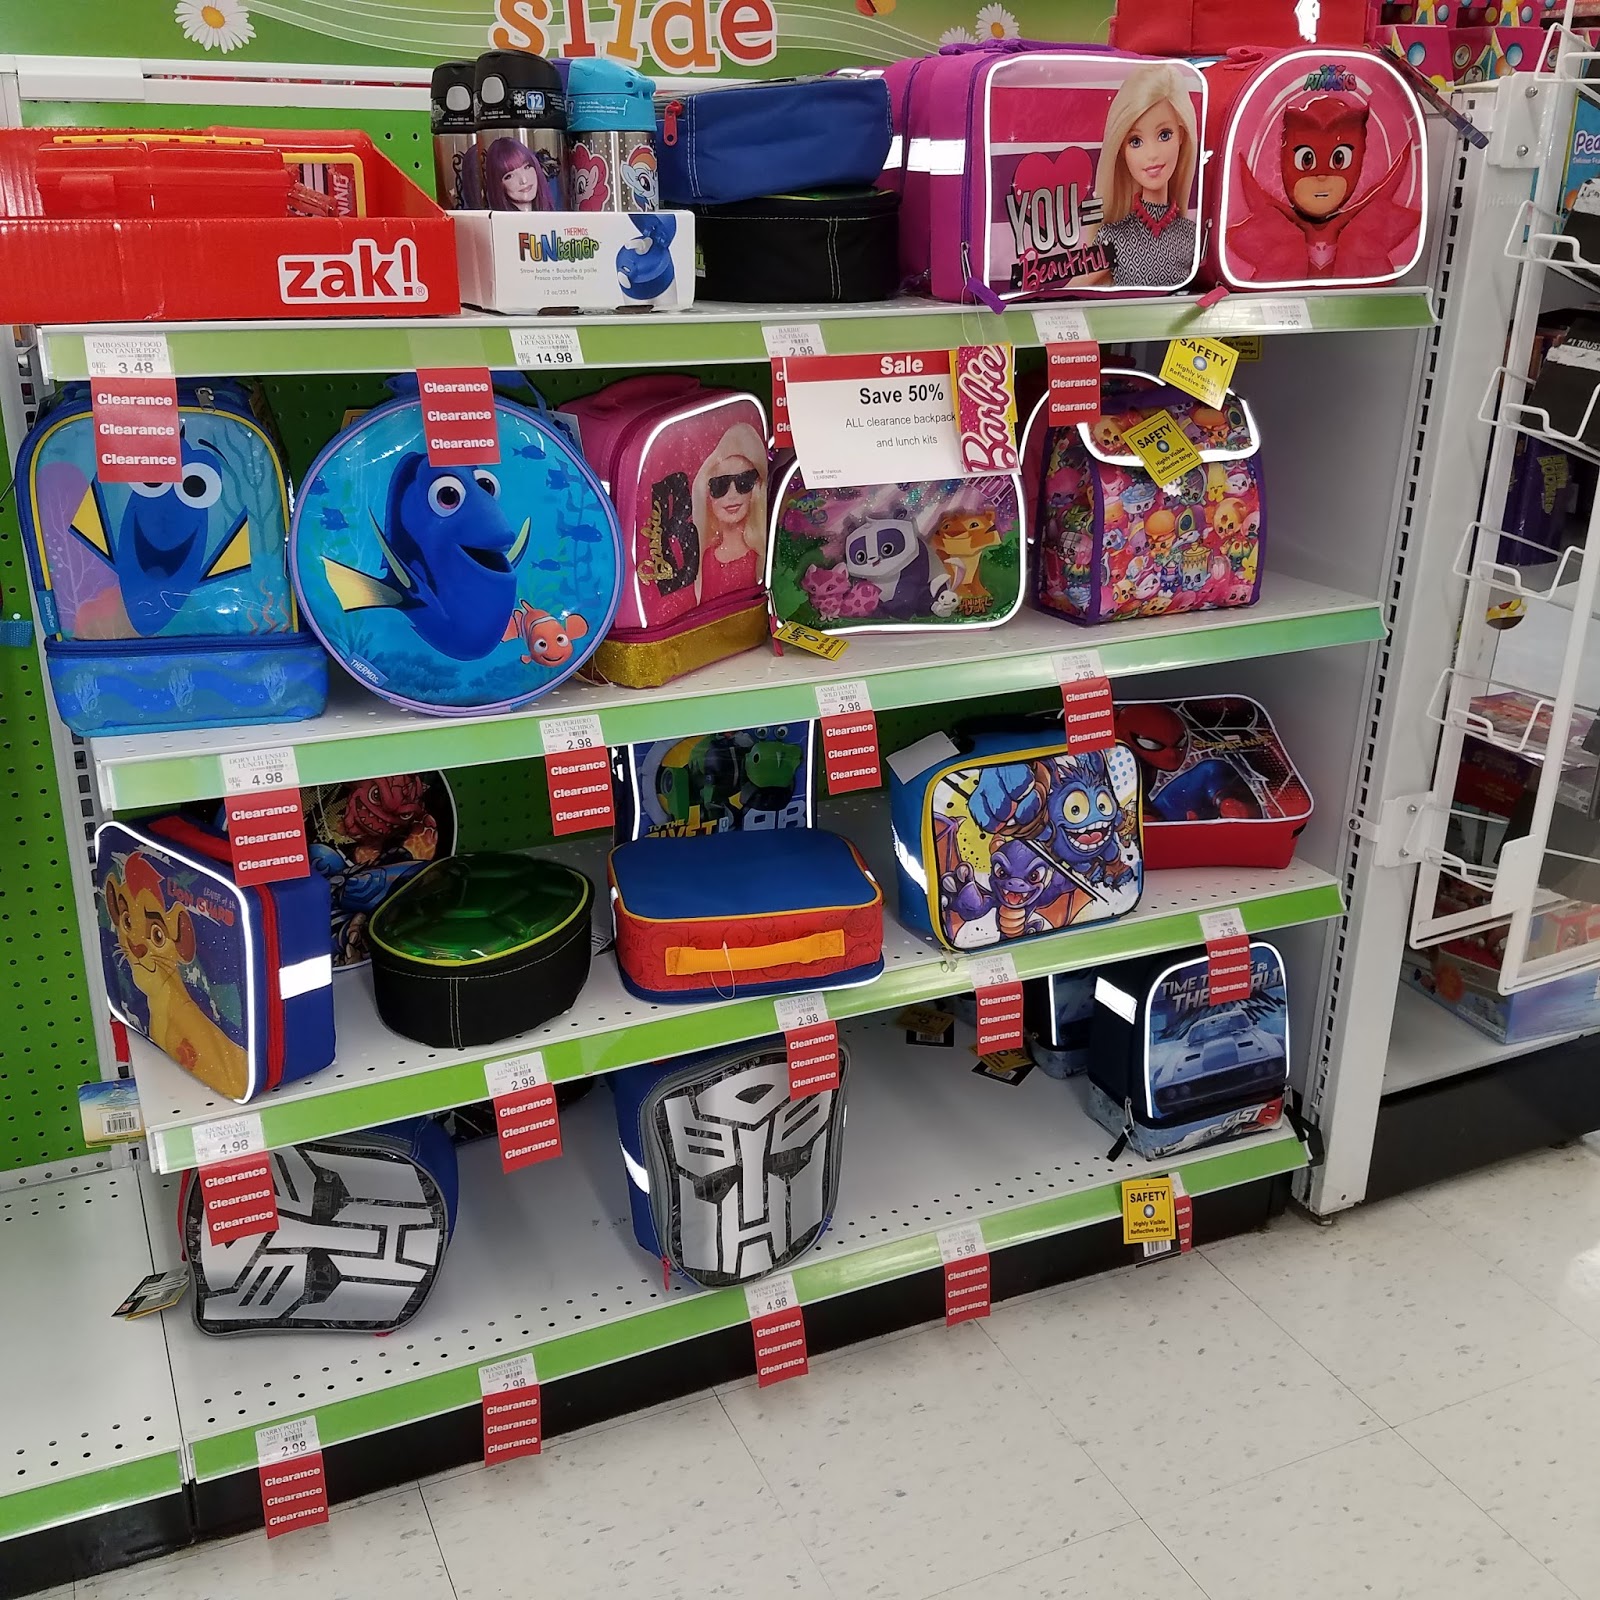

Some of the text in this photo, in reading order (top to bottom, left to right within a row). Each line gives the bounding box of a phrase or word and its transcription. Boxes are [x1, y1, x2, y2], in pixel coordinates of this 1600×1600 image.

[563, 227, 589, 236] THERMOS
[1020, 243, 1110, 291] Beautiful
[1057, 331, 1080, 341] 4.98
[536, 352, 573, 364] 14.98
[1050, 353, 1098, 365] Clearance
[1180, 338, 1228, 367] SAFETY
[118, 362, 154, 374] 3.48
[880, 355, 924, 375] Sale
[1175, 362, 1195, 376] Highly
[1051, 377, 1098, 389] Clearance
[1169, 367, 1199, 387] Reflective
[424, 383, 489, 393] Clearance
[859, 382, 944, 405] Save 50%
[97, 393, 173, 406] Clearance
[1051, 401, 1098, 413] Clearance
[427, 410, 492, 422] Clearance
[961, 345, 1018, 472] Barbie
[845, 411, 956, 429] ALL clearance backpack
[99, 423, 175, 436] Clearance
[1136, 423, 1172, 449] SAFETY
[431, 438, 495, 450] Clearance
[876, 434, 938, 448] and lunch kits
[101, 453, 177, 466] Clearance
[350, 658, 379, 684] THERMOS
[1074, 670, 1096, 680] 2.98
[1066, 689, 1109, 702] Clearance
[838, 701, 861, 713] 2.98
[1068, 709, 1111, 723] Clearance
[826, 723, 874, 737] Clearance
[1070, 729, 1112, 743] Clearance
[566, 737, 593, 750] 2.98
[828, 745, 876, 759] Clearance
[551, 760, 607, 776] Clearance
[830, 766, 877, 780] Clearance
[251, 772, 283, 786] 4.98
[553, 783, 609, 799] Clearance
[231, 804, 298, 821] Clearance
[556, 805, 611, 821] Clearance
[235, 829, 301, 846] Clearance
[238, 853, 305, 871] Clearance
[1210, 946, 1248, 958] Clearance
[1211, 964, 1249, 976] Clearance
[989, 973, 1009, 985] 2.98
[1161, 977, 1198, 996] TIME
[1211, 982, 1248, 995] Clearance
[980, 993, 1021, 1007] Clearance
[1172, 988, 1210, 1013] THE
[797, 1013, 819, 1026] 2.98
[980, 1012, 1021, 1025] Clearance
[790, 1033, 835, 1050] Clearance
[980, 1030, 1020, 1044] Clearance
[791, 1052, 836, 1070] Clearance
[496, 1067, 519, 1076] LUNCH
[511, 1075, 536, 1091] 2.98
[792, 1071, 837, 1089] Clearance
[499, 1097, 553, 1118] Clearance
[502, 1118, 556, 1138] Clearance
[219, 1139, 249, 1154] 4.98
[505, 1138, 558, 1159] Clearance
[205, 1167, 268, 1188] Clearance
[208, 1189, 271, 1210] Clearance
[1130, 1190, 1167, 1203] SAFETY
[212, 1211, 274, 1232] Clearance
[1133, 1220, 1149, 1228] Highly
[956, 1243, 977, 1257] 5.98
[948, 1265, 988, 1281] Clearance
[948, 1283, 988, 1299] Clearance
[766, 1297, 788, 1311] 4.98
[948, 1300, 988, 1316] Clearance
[756, 1319, 801, 1338] Clearance
[758, 1338, 803, 1357] Clearance
[482, 1357, 528, 1375] TRANSFORMERS
[760, 1357, 805, 1376] Clearance
[488, 1370, 509, 1379] LUNCH
[503, 1378, 527, 1391] 298
[486, 1398, 538, 1415] Clearance
[260, 1420, 308, 1438] HARRY POTTER
[487, 1417, 538, 1435] Clearance
[281, 1440, 307, 1457] 2.98
[487, 1437, 538, 1454] Clearance
[264, 1467, 321, 1487] Clearance
[266, 1487, 323, 1507] Clearance
[269, 1506, 325, 1526] Clearance
